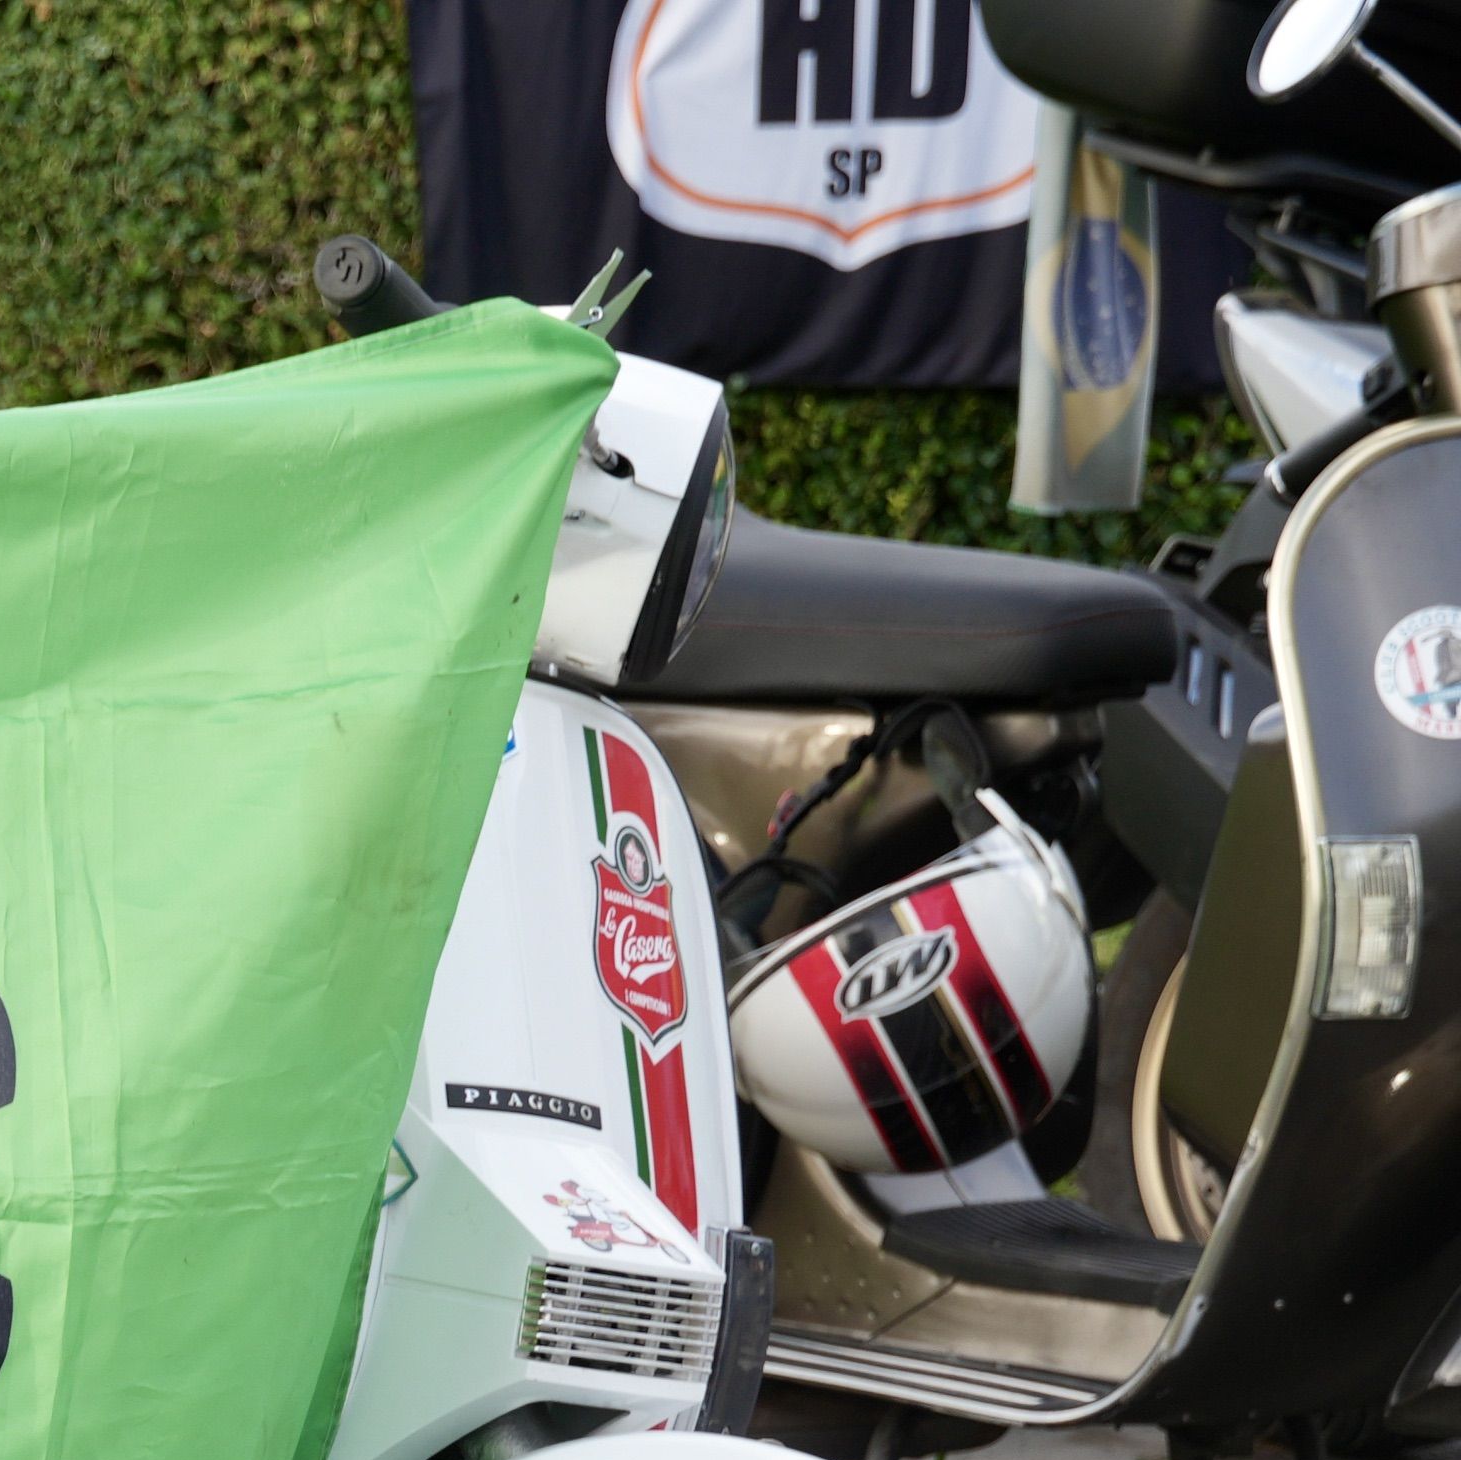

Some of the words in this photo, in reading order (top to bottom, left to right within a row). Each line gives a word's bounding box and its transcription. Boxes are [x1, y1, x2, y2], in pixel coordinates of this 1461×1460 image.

[757, 0, 971, 122] HD
[828, 148, 883, 197] SP
[614, 914, 676, 985] Casera
[463, 1087, 593, 1122] PIAGGIO
